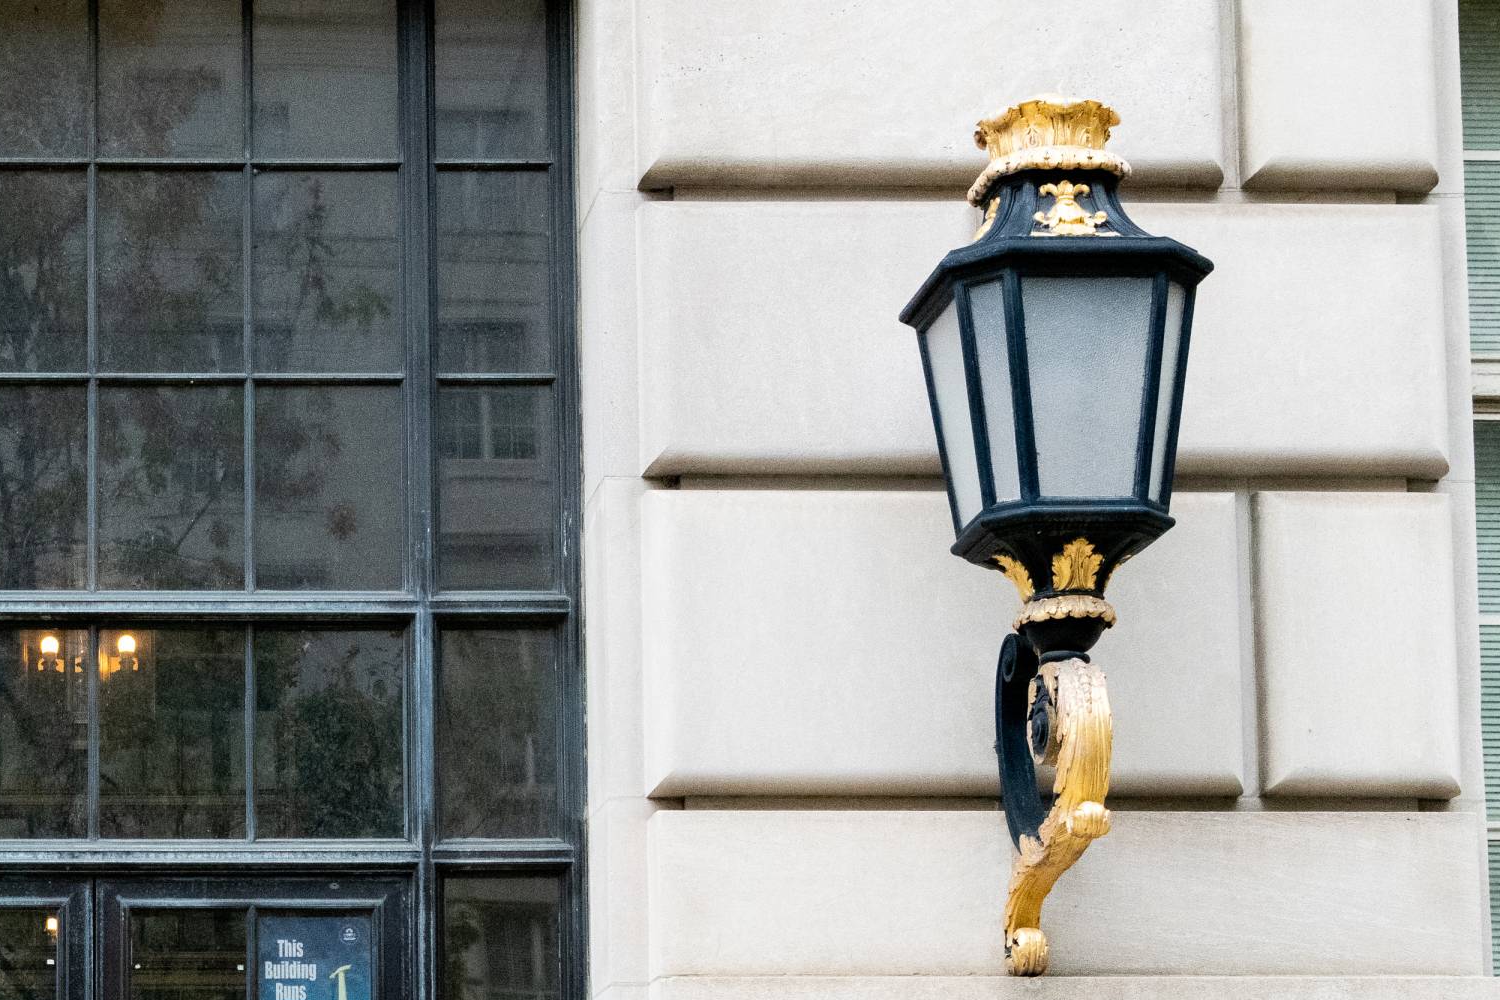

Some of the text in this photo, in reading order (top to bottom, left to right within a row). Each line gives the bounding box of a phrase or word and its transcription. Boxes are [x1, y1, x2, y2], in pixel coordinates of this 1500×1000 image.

[277, 939, 304, 958] This
[265, 961, 317, 981] Building
[275, 983, 307, 1000] Runs
